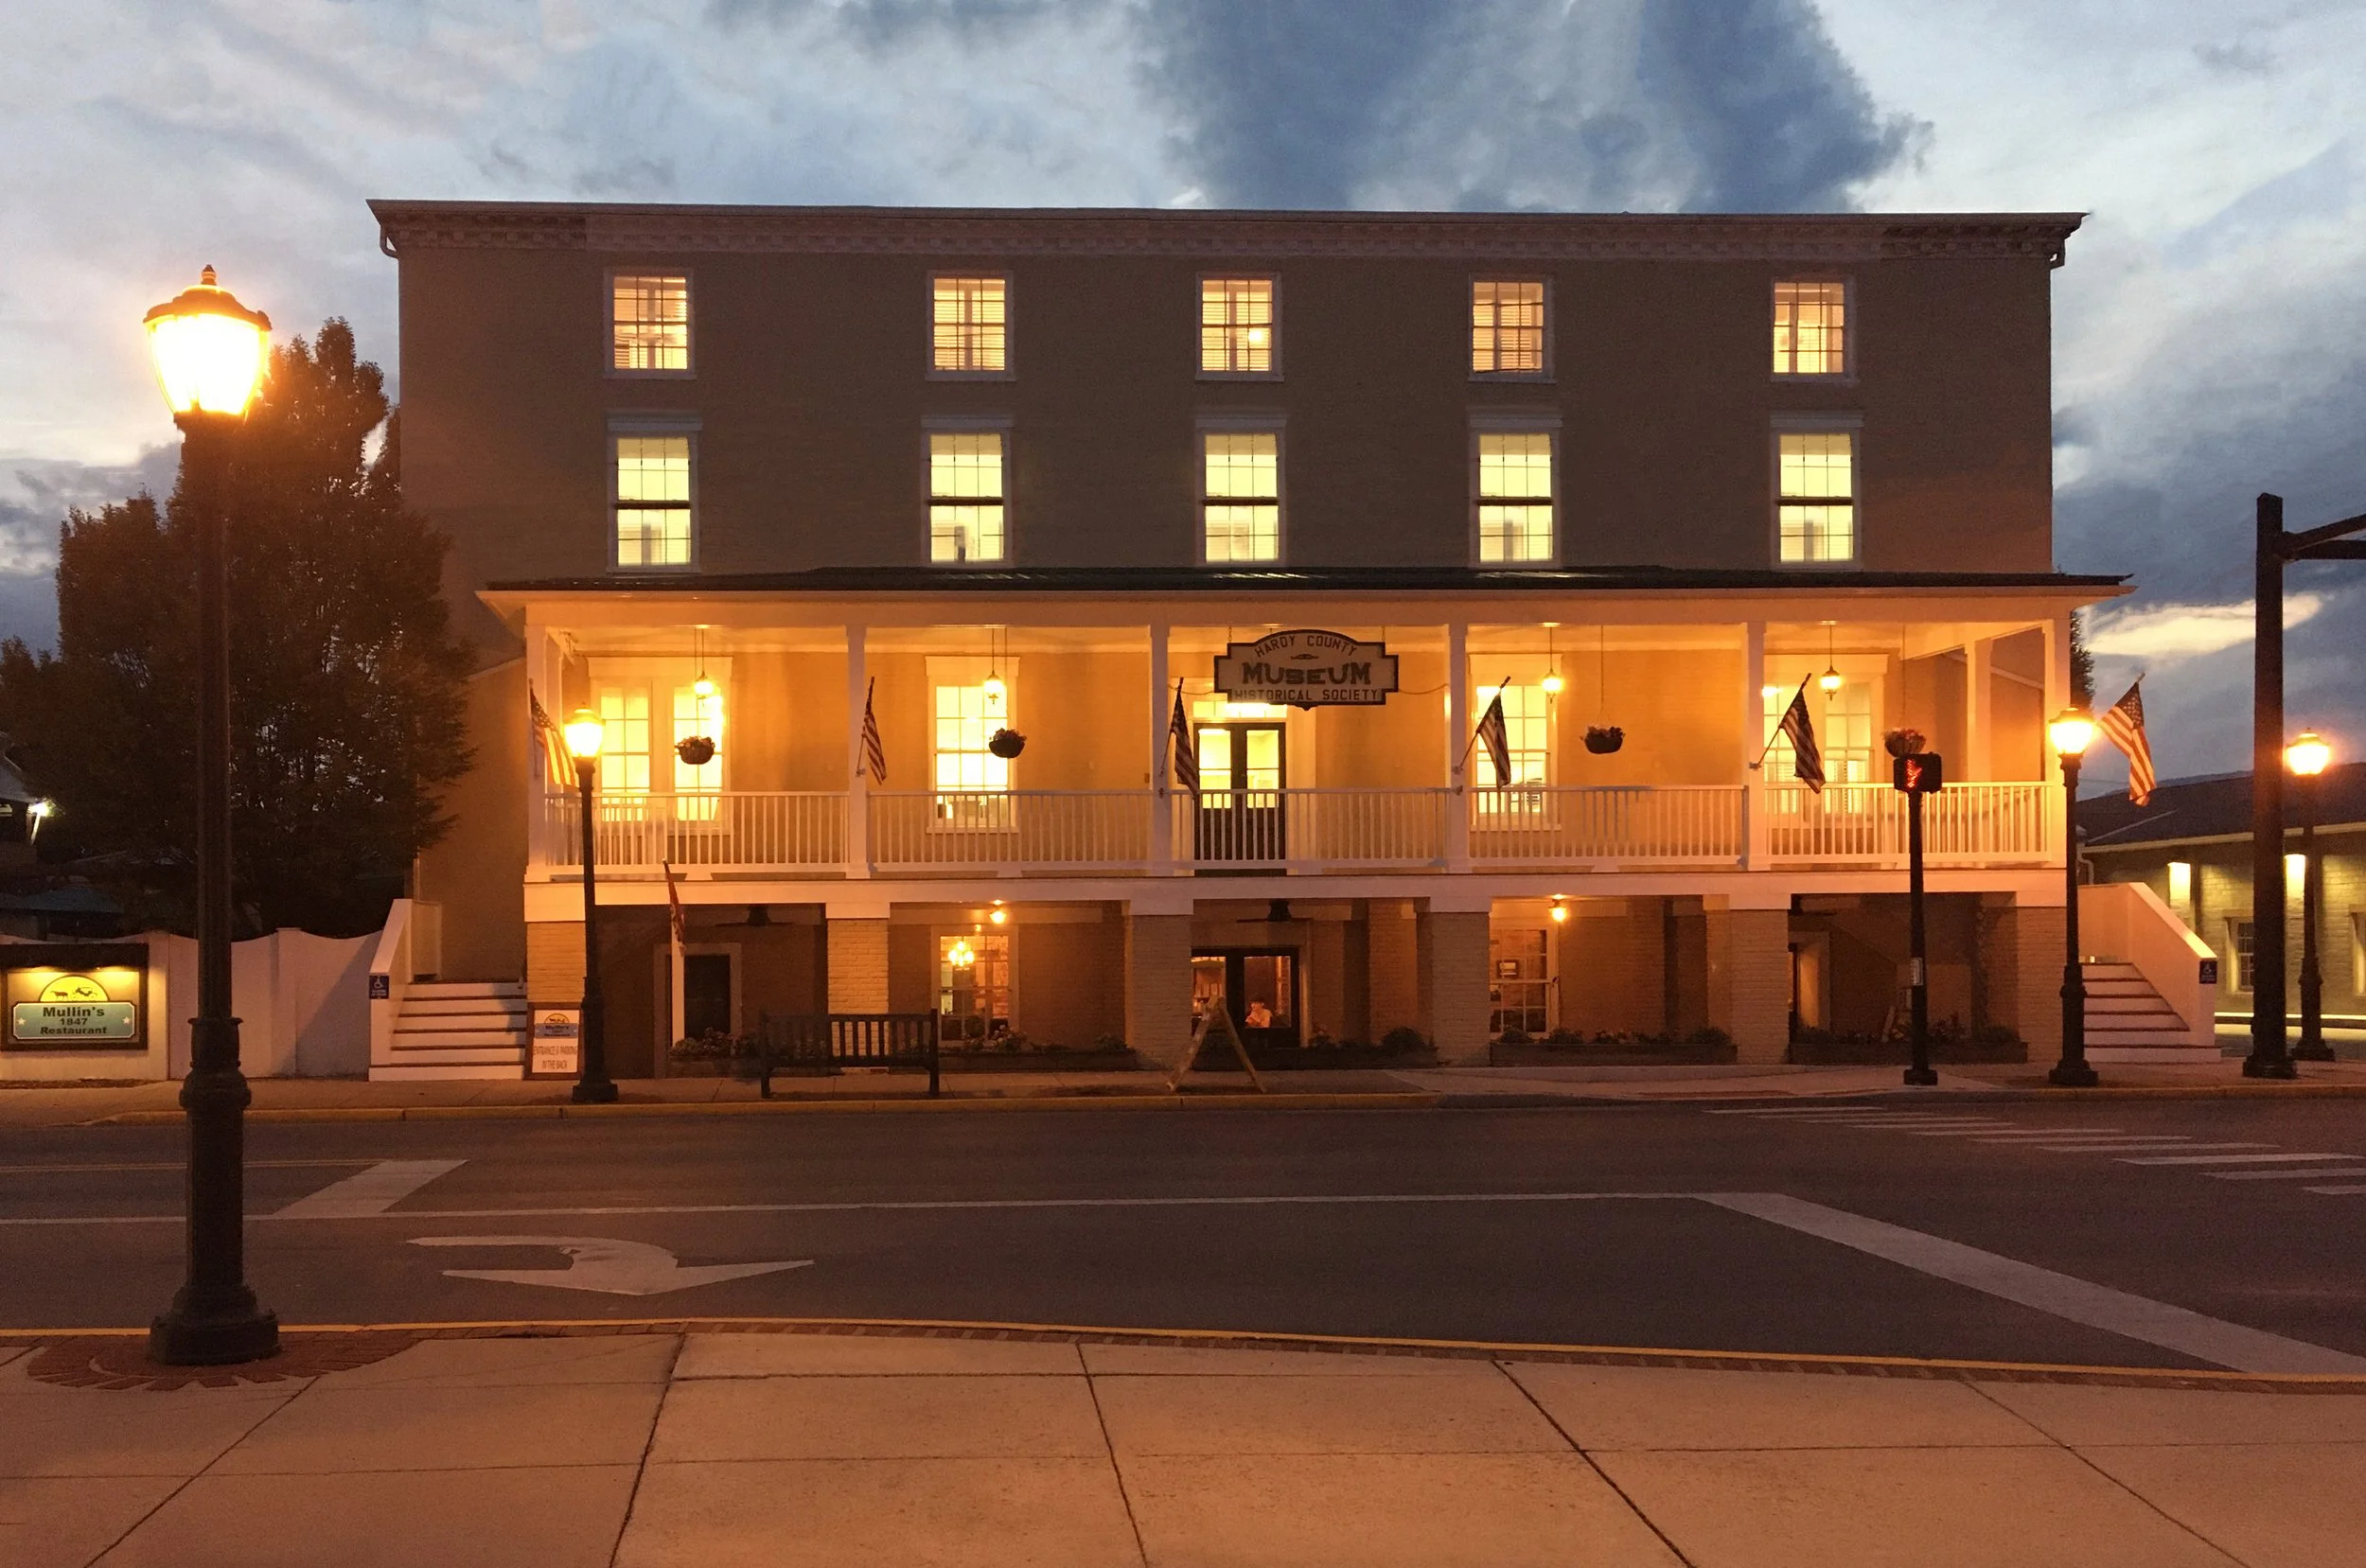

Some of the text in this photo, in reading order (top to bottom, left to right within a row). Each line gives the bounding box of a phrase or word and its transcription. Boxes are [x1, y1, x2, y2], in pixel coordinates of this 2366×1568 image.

[1254, 635, 1357, 658] HARDY COUNTY
[1242, 661, 1371, 685] MUSEUM
[1234, 689, 1378, 701] HISTORICAL SOCIETY
[43, 1007, 105, 1016] Mullin's
